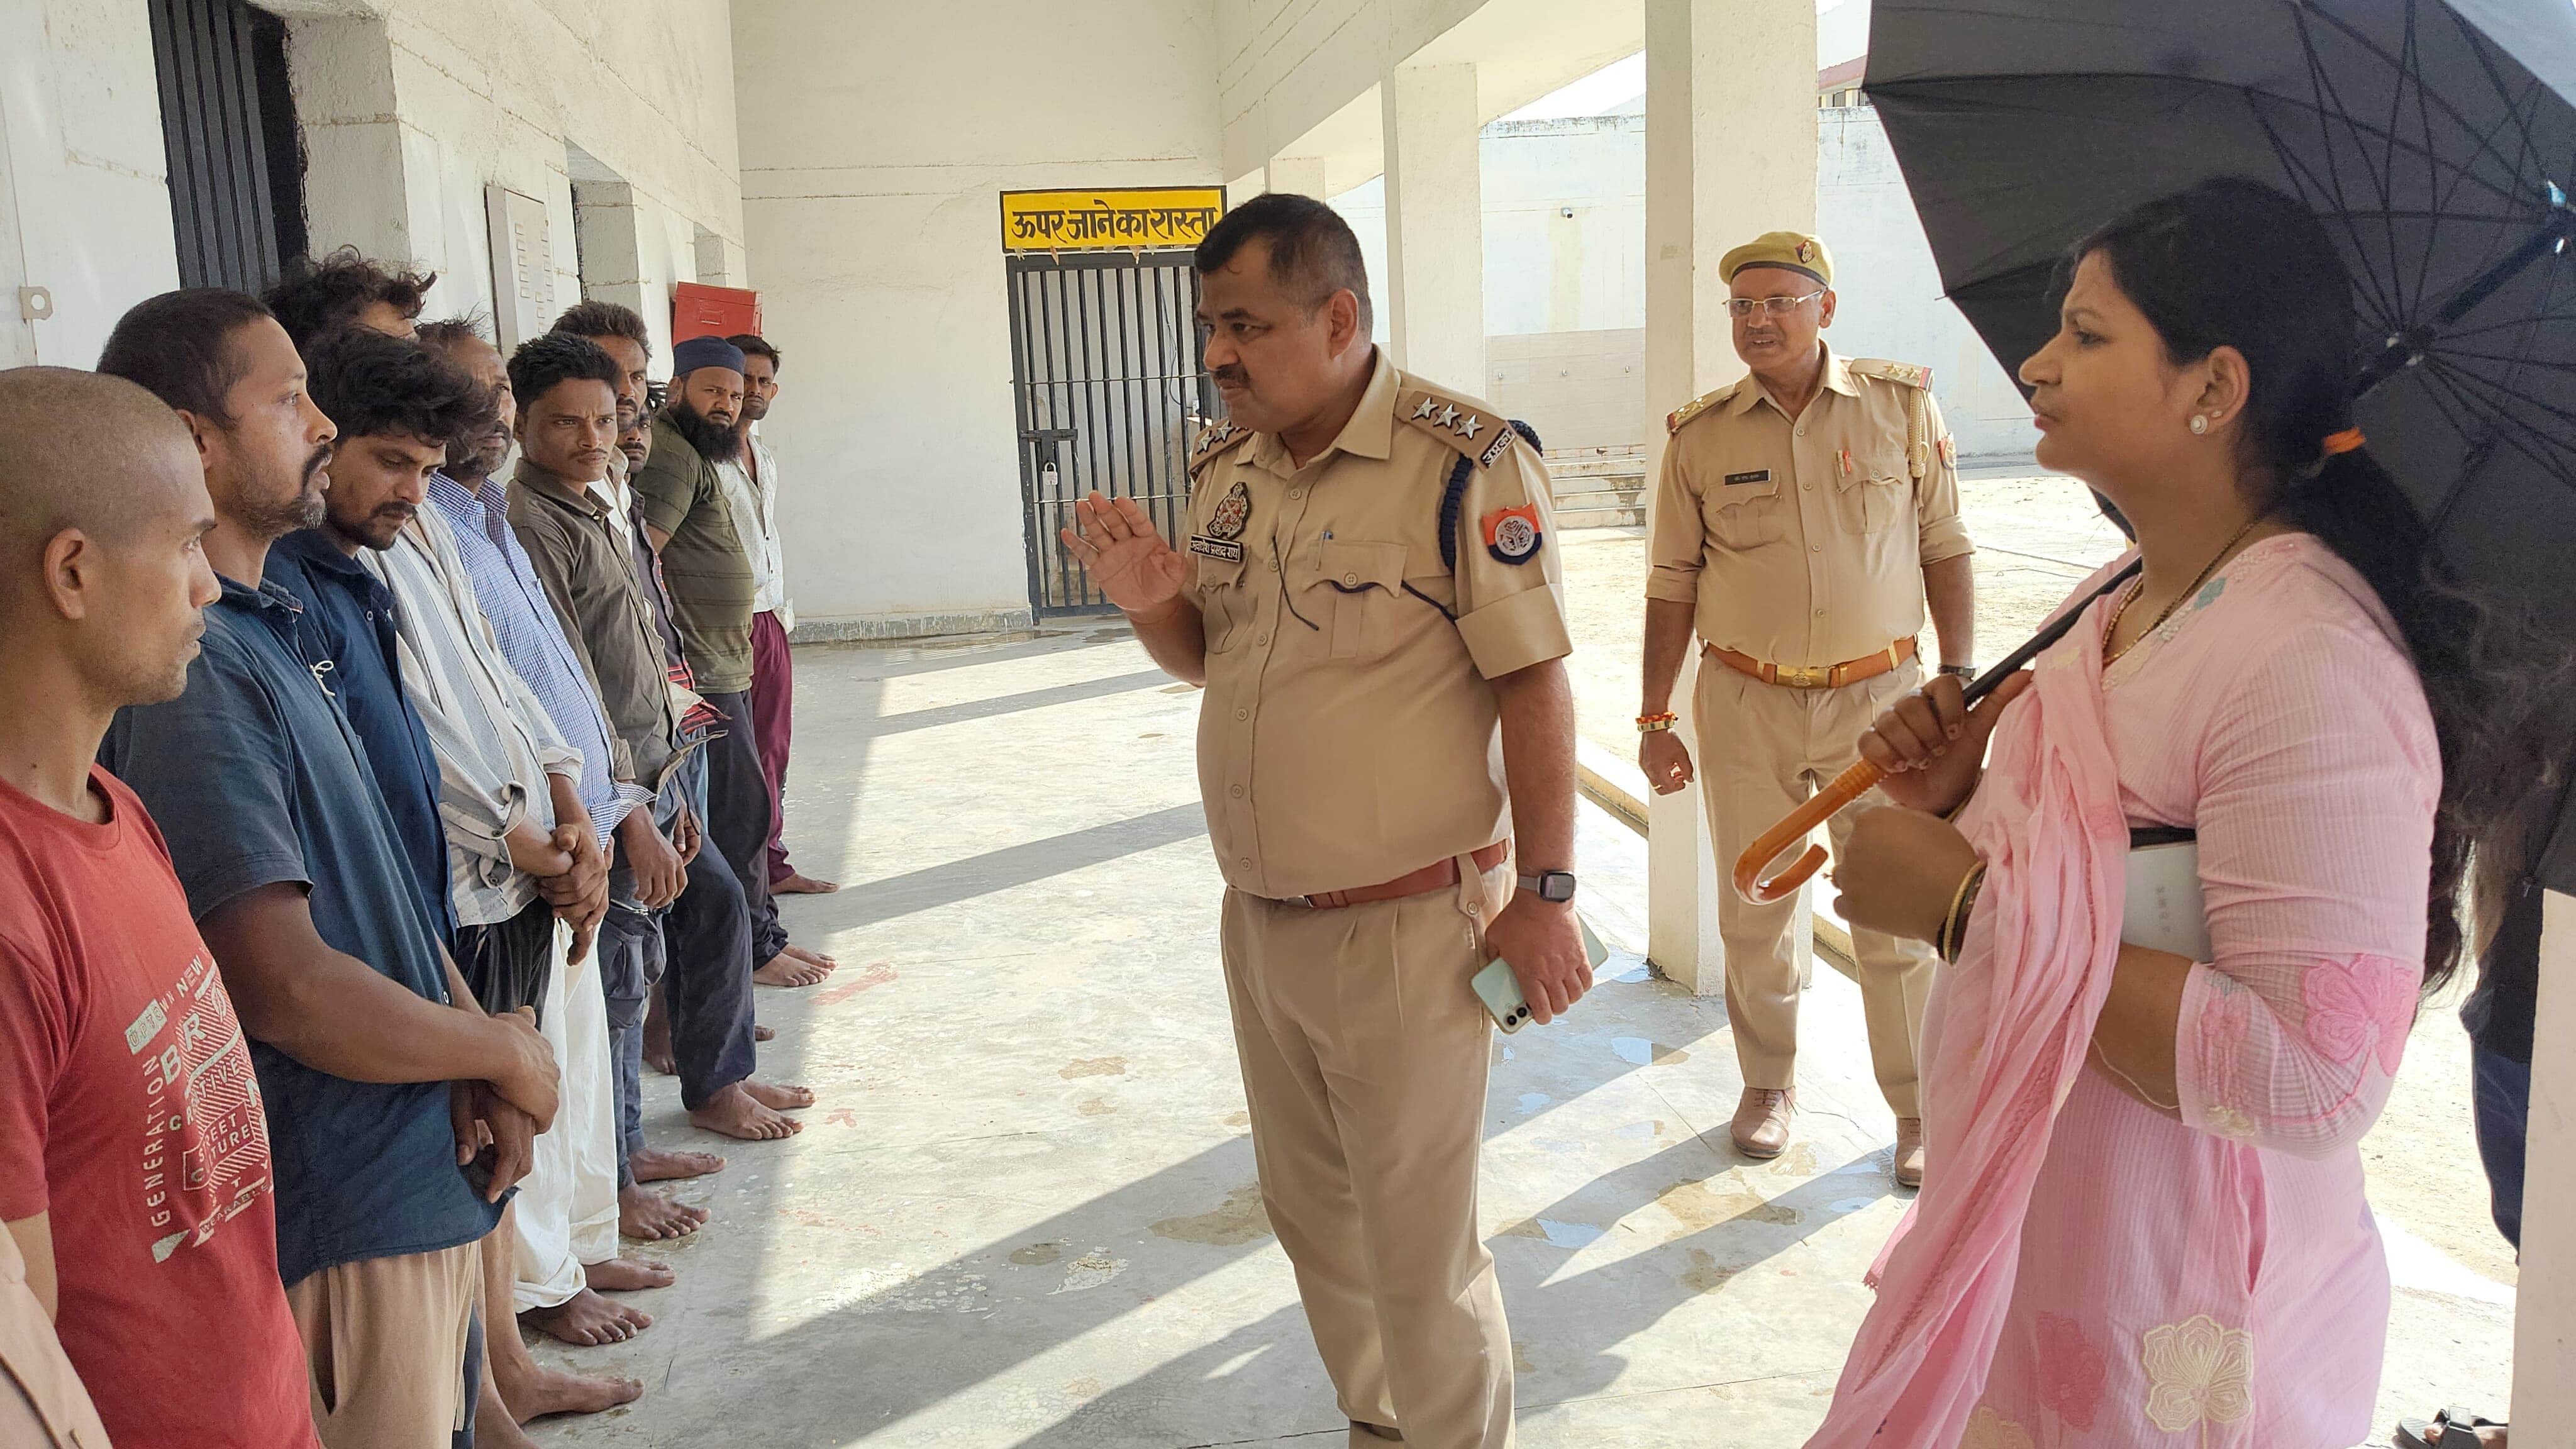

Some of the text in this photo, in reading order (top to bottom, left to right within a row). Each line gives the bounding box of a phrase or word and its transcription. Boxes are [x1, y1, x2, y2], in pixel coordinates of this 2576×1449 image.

[1011, 199, 1218, 243] ऊपर जाने का रास्ता
[176, 955, 204, 997] NEW
[143, 1055, 170, 1227] GENERATION
